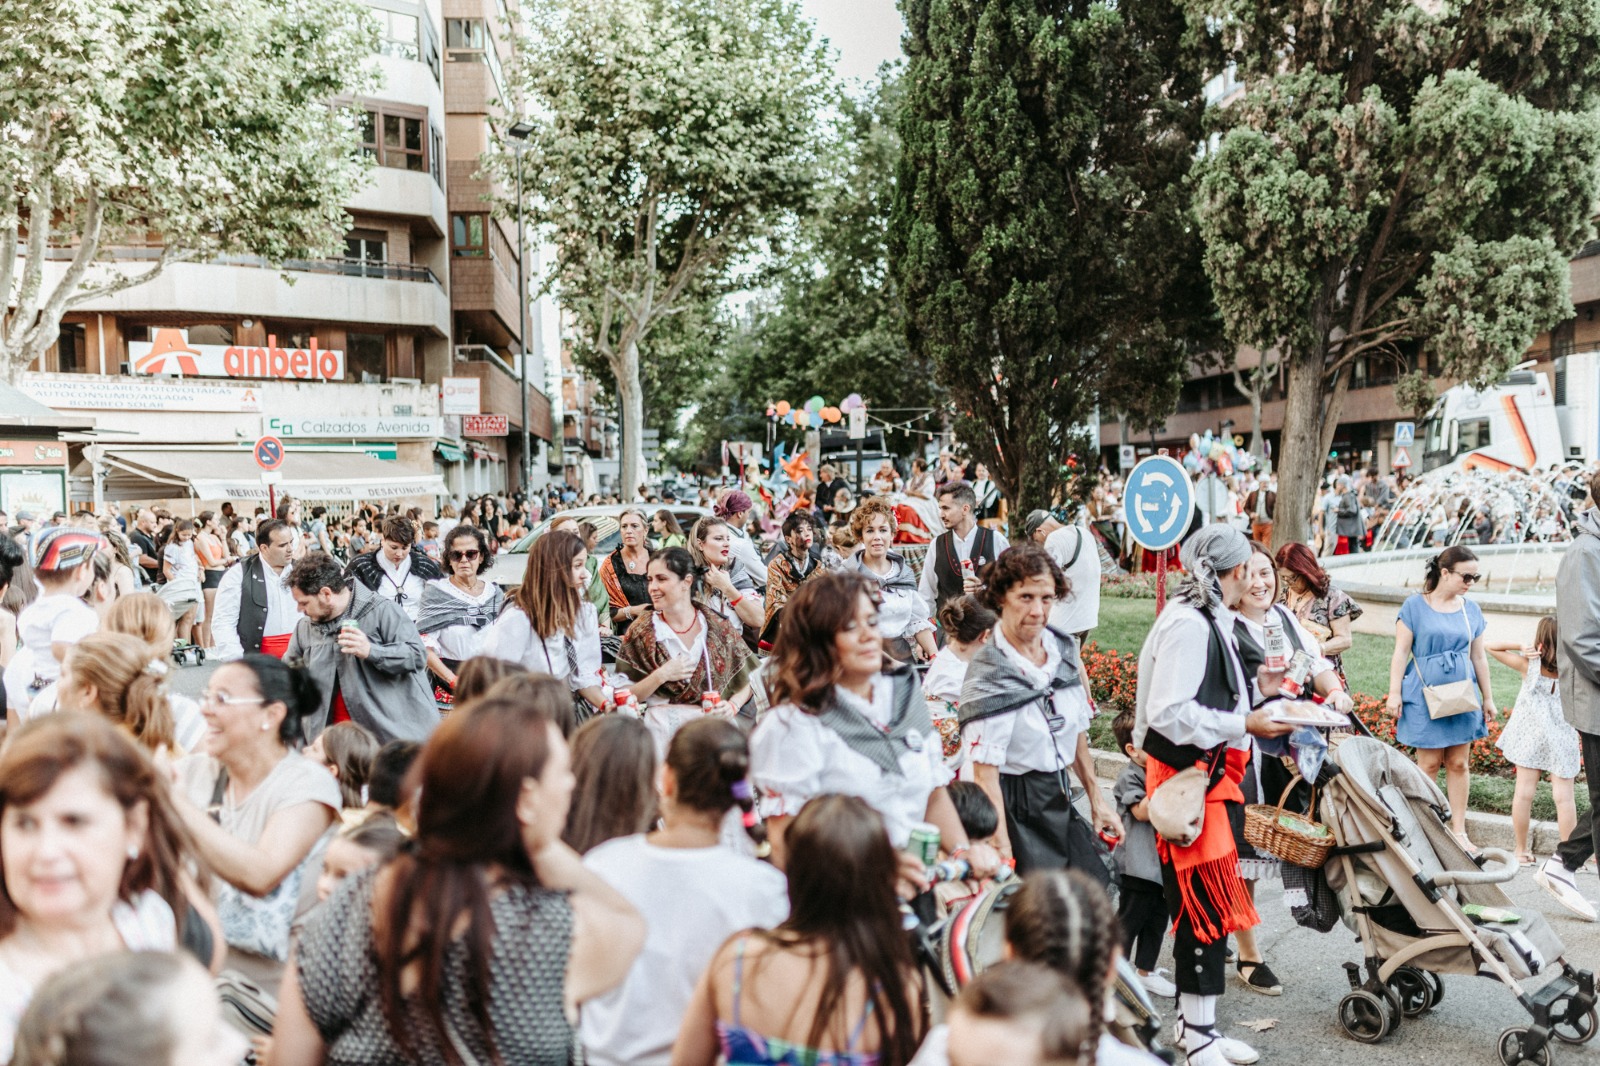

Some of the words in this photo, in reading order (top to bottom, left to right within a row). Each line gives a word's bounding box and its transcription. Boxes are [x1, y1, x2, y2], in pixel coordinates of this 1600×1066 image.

[224, 334, 338, 379] anbelo
[21, 381, 86, 390] LACIONES
[89, 383, 141, 392] SOLARES
[145, 385, 232, 395] FOTOVOLTAICAS
[35, 390, 194, 401] AUTOCONSUMO/AISLADAS
[69, 400, 124, 408] BOMBEO
[127, 401, 164, 409] SOLAR
[301, 420, 367, 434] Calzados
[376, 420, 430, 434] Avenida
[465, 422, 506, 431] CHINO
[225, 488, 288, 498] MERIENA
[368, 486, 427, 497] DESAYUNOS
